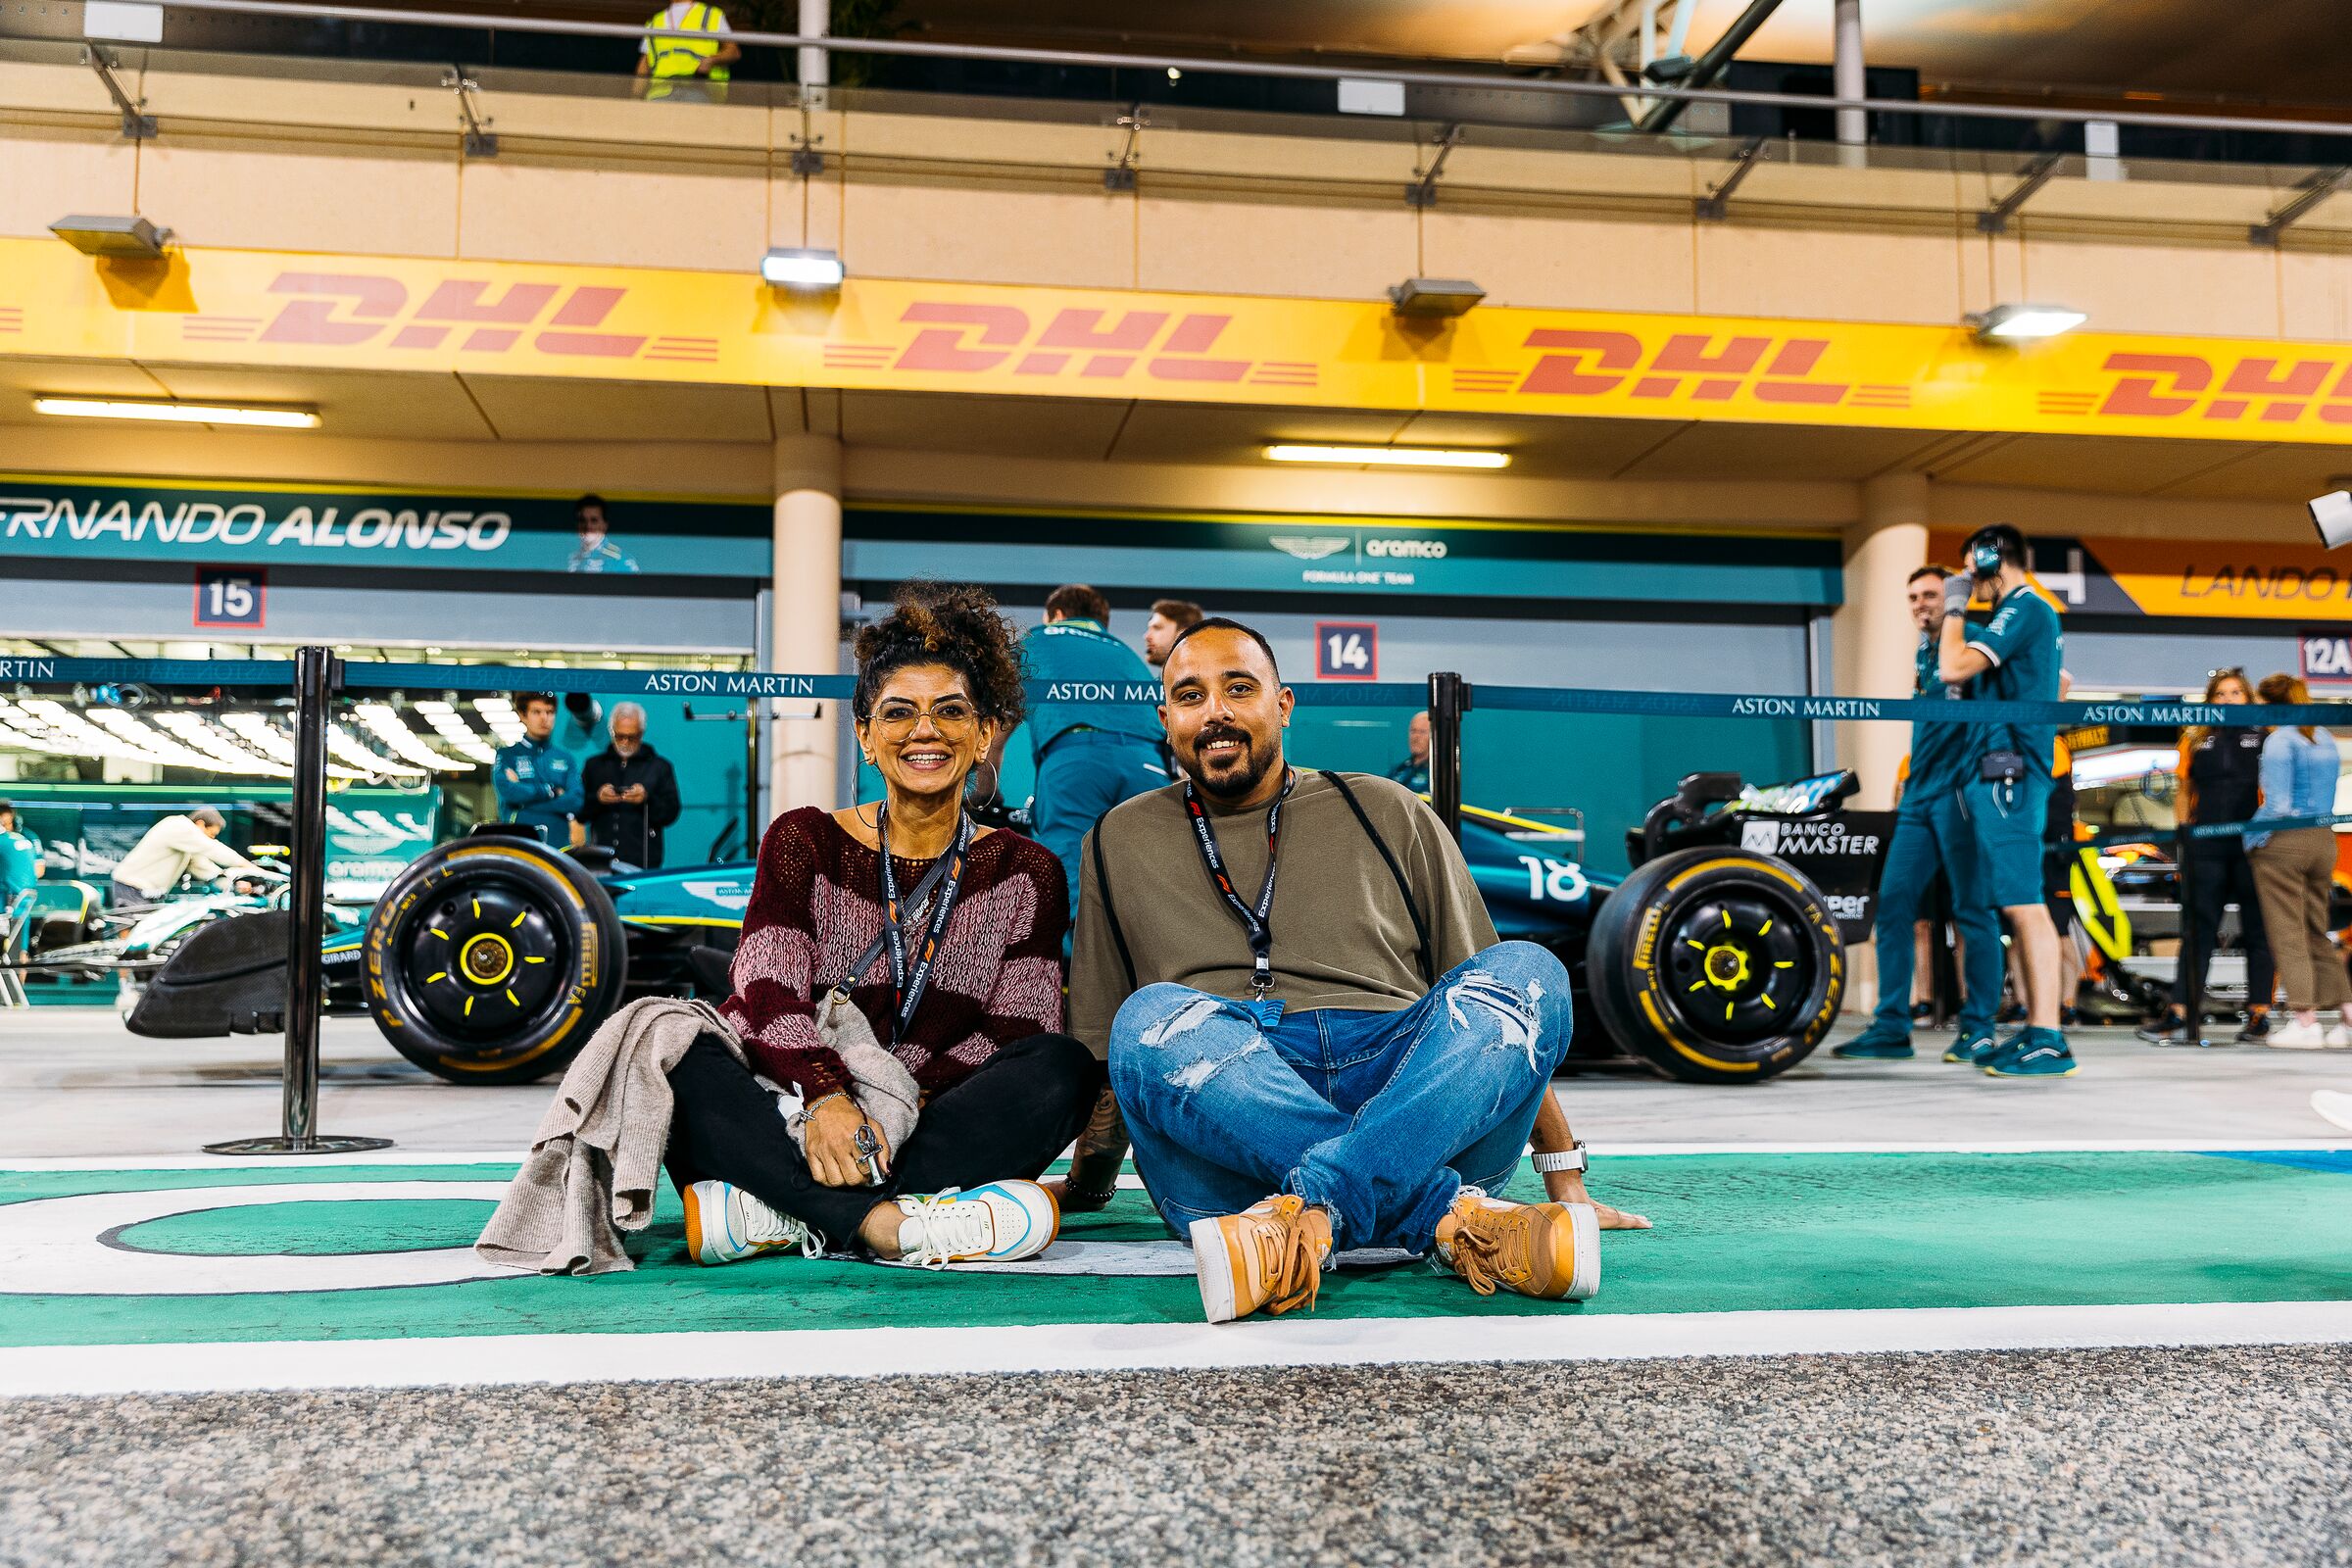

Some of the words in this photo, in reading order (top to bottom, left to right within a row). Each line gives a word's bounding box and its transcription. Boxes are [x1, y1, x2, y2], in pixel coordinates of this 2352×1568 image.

[257, 271, 647, 359] DHL
[894, 302, 1252, 383] DHL
[1519, 328, 1849, 405] DHL
[0, 497, 267, 545] RNANDO
[267, 506, 512, 551] ALONSO
[1366, 539, 1447, 559] aramco
[209, 578, 253, 617] 15
[2180, 564, 2338, 601] LANDO
[1328, 633, 1369, 669] 14
[2304, 638, 2352, 674] 12A
[645, 674, 716, 692] ASTON
[726, 676, 813, 694] MARTIN
[1046, 683, 1115, 701] ASTON
[1732, 698, 1795, 715] ASTON
[1803, 700, 1881, 716] MARTIN
[2082, 706, 2144, 722] ASTON
[2151, 707, 2226, 722] MARTIN
[1778, 836, 1880, 855] MASTER
[1781, 822, 1845, 837] BANCO
[1196, 816, 1219, 869] Experiences
[1227, 893, 1260, 932] Experiences
[1518, 856, 1588, 902] 18
[932, 880, 956, 933] Experiences
[368, 900, 396, 1000] ZERO
[580, 922, 598, 988] PIRELLI
[892, 930, 904, 988] Experiences
[1633, 906, 1662, 970] PIRELLI
[901, 961, 928, 1017] Experiences
